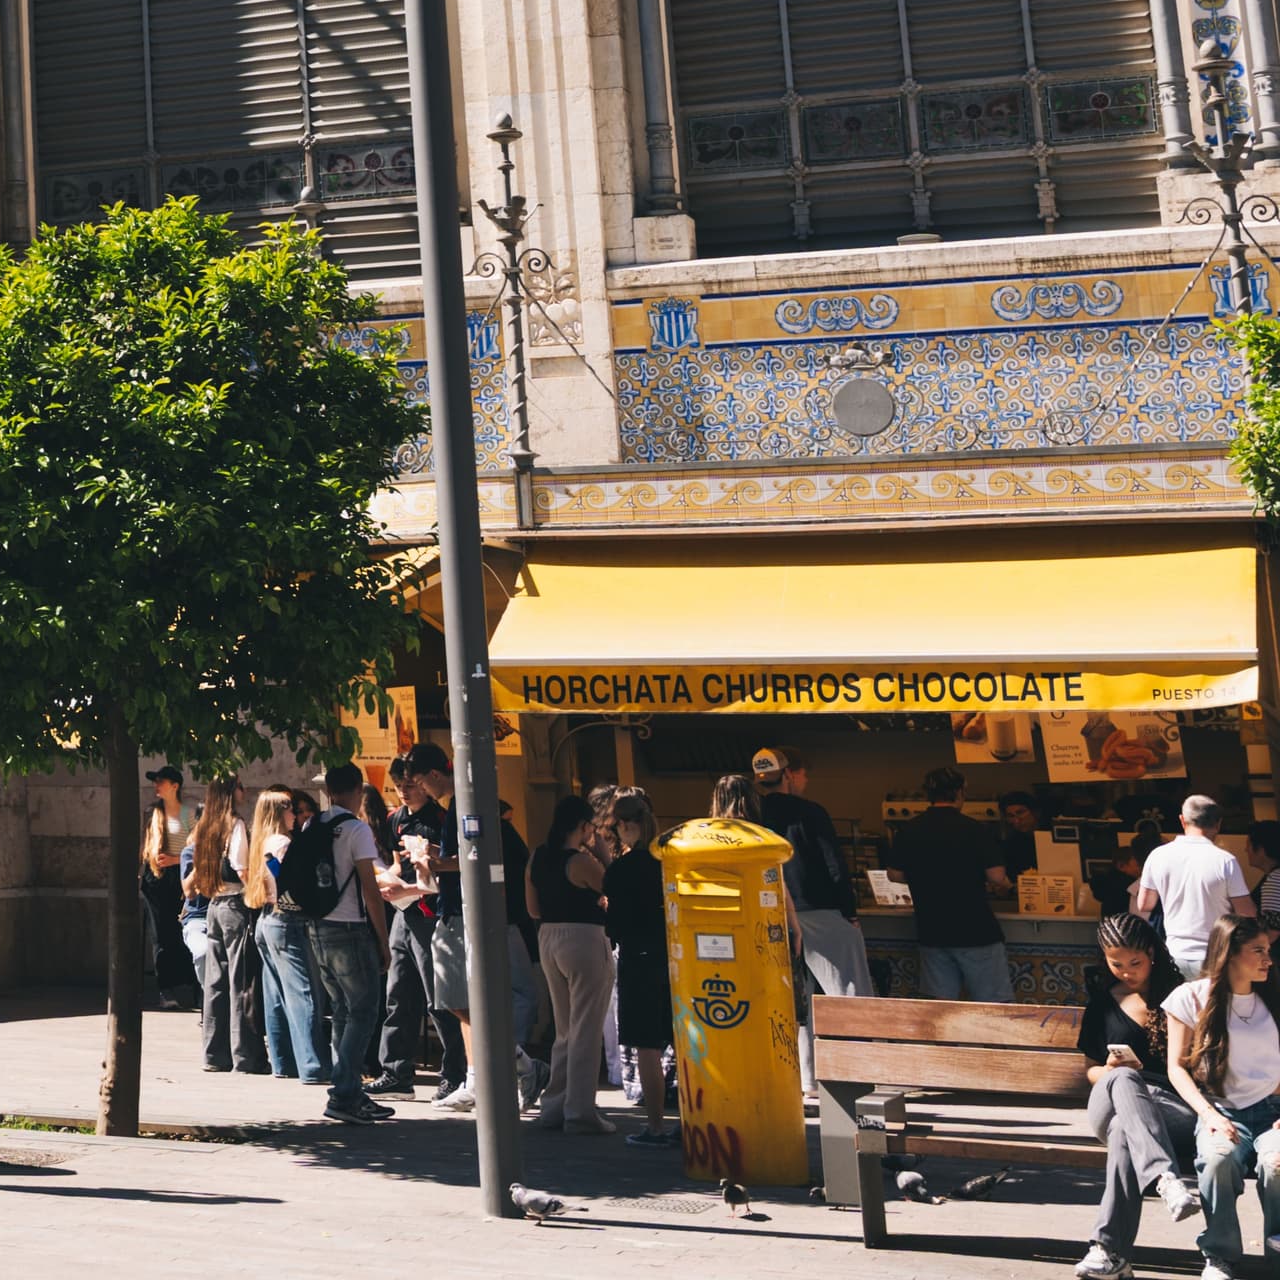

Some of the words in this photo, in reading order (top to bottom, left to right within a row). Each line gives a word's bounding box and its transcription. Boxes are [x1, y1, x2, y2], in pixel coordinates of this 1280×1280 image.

[522, 673, 693, 705] HORCHATA
[702, 672, 861, 704] CHURROS
[872, 671, 1085, 704] CHOCOLATE
[1151, 686, 1215, 702] PUESTO
